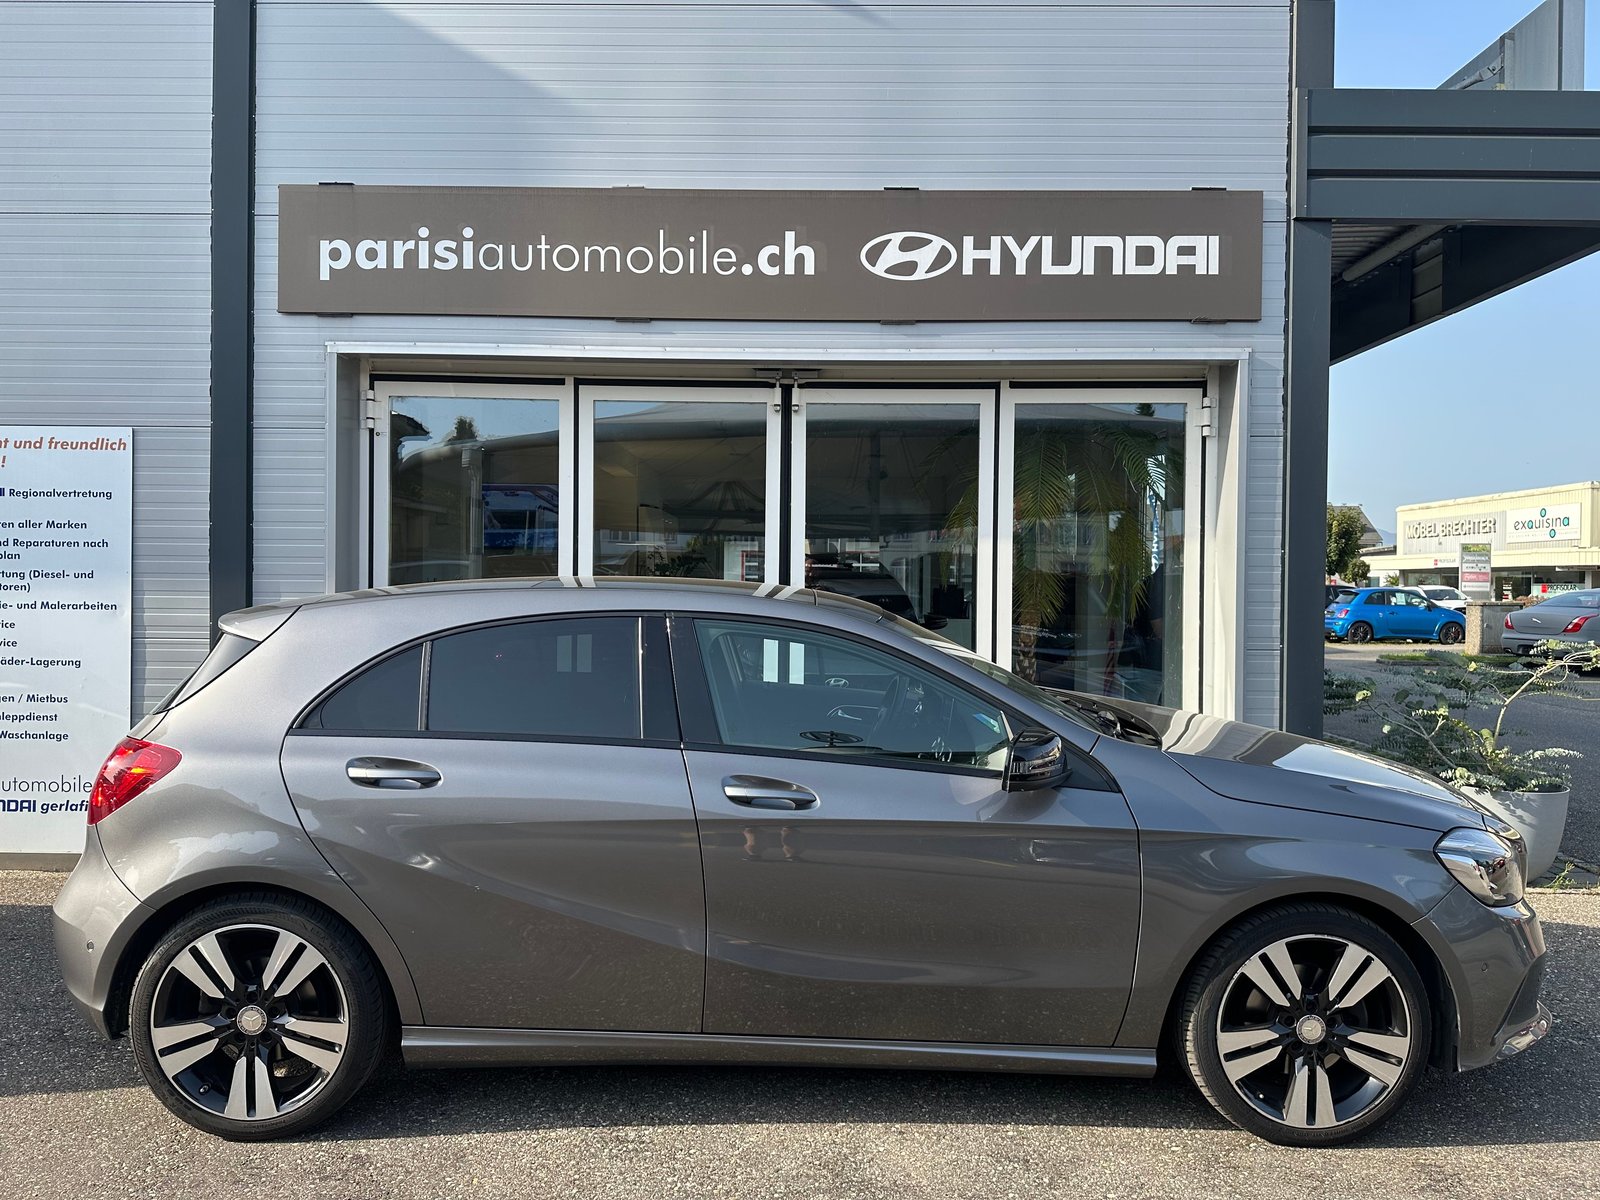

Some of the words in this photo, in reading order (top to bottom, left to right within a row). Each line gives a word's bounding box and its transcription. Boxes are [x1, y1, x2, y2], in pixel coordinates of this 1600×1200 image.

[319, 226, 816, 281] parisiautomobile.ch
[962, 235, 1220, 276] HYUNDAI
[13, 436, 44, 450] und
[48, 436, 127, 451] freundlich
[9, 488, 113, 500] Regionalvertretung
[18, 519, 43, 529] aller
[46, 519, 88, 530] Marken
[1406, 521, 1440, 540] MÖBEL
[1440, 517, 1497, 537] BRECHTER
[13, 538, 80, 550] Reparaturen
[83, 538, 109, 548] nach
[29, 569, 71, 581] (Diesel-
[73, 569, 95, 579] und
[16, 600, 37, 610] und
[40, 600, 118, 611] Malerarbeiten
[26, 693, 69, 704] Mietbus
[0, 711, 58, 723] leppdienst
[0, 730, 70, 743] Waschanlage
